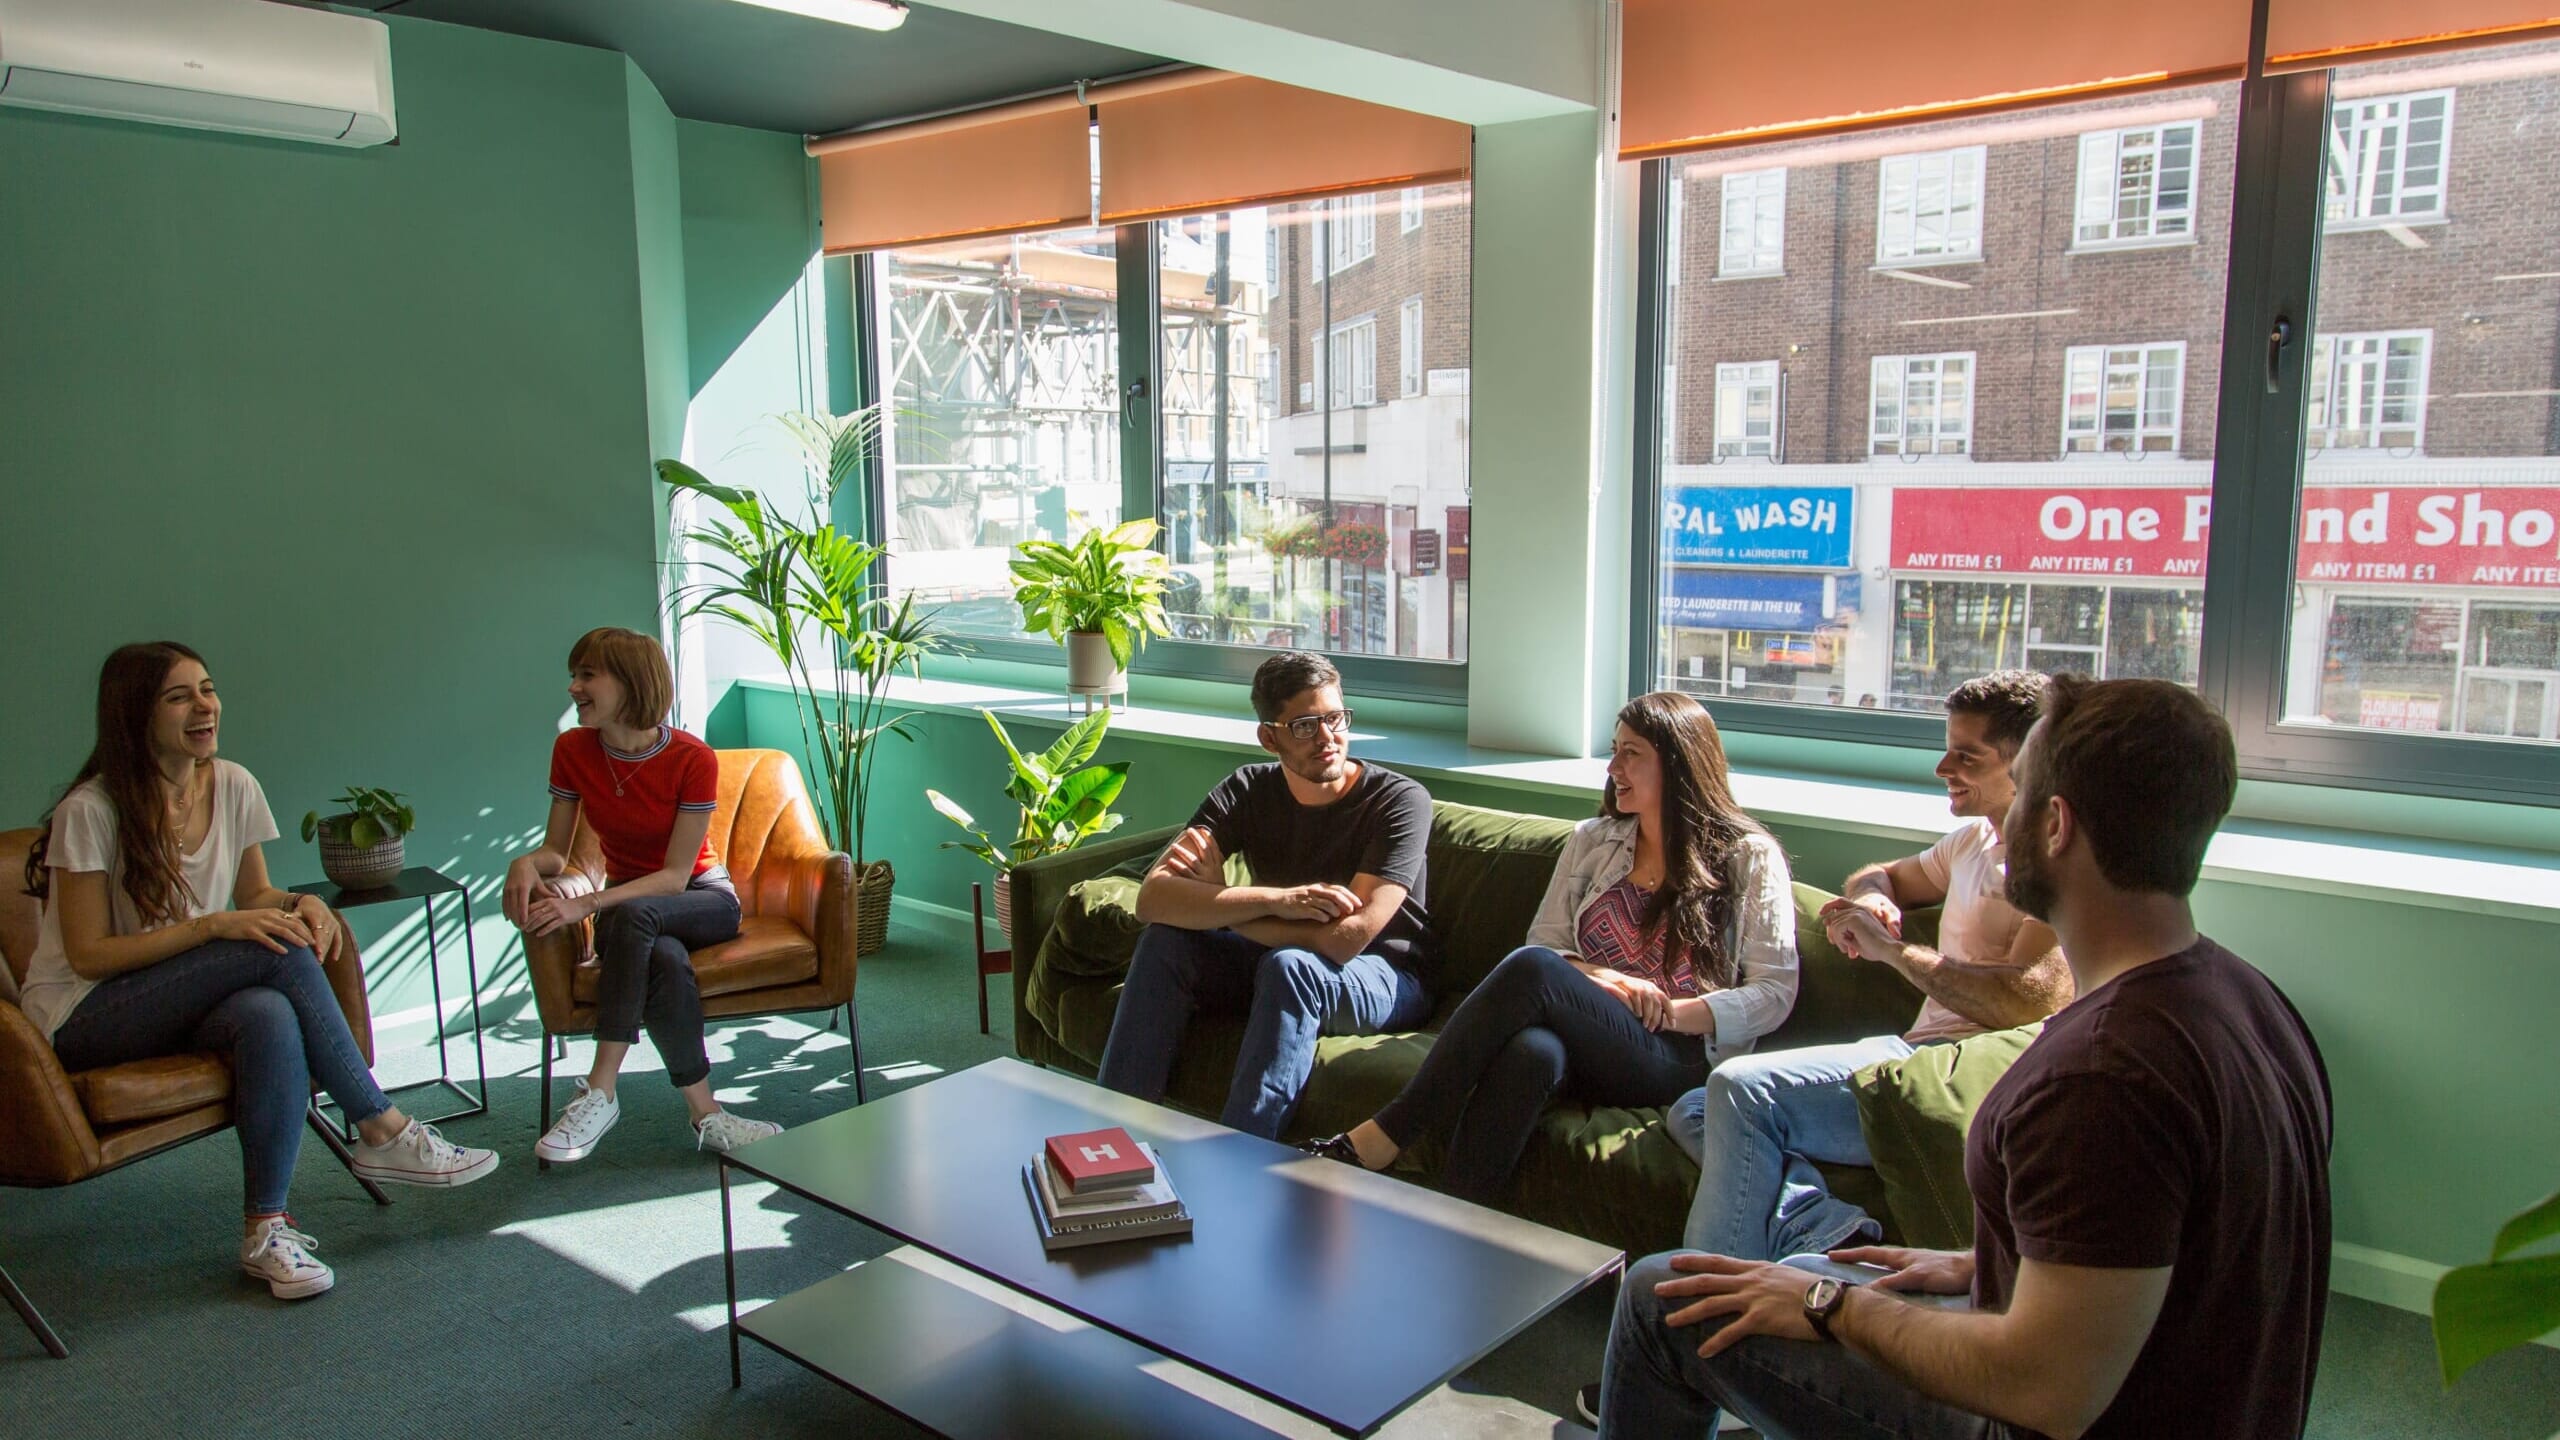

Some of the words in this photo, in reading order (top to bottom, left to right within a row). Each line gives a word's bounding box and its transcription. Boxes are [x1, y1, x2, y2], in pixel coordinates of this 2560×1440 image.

[1735, 498, 1837, 534] WASH
[2039, 495, 2160, 541] One
[2414, 492, 2560, 560] Sho
[1675, 547, 1723, 557] CLEANERS
[1728, 548, 1735, 558] &
[1739, 548, 1808, 560] LAUNDERETTE
[1907, 553, 1938, 567] ANY
[1942, 554, 1979, 568] ITEM
[1984, 555, 2002, 569] £1
[2029, 555, 2064, 570] ANY
[2067, 556, 2108, 571] ITEM
[2114, 557, 2133, 572] £1
[2163, 558, 2201, 573] ANY
[2310, 562, 2351, 577] ANY
[2356, 563, 2406, 579] ITEM
[2412, 564, 2436, 580] £1
[2472, 566, 2518, 582] ANY
[2523, 567, 2560, 584] ITE
[1683, 598, 1749, 611] LAUNDERETTE
[1751, 600, 1762, 612] IN
[1765, 601, 1783, 613] THE
[1079, 1144, 1120, 1162] H
